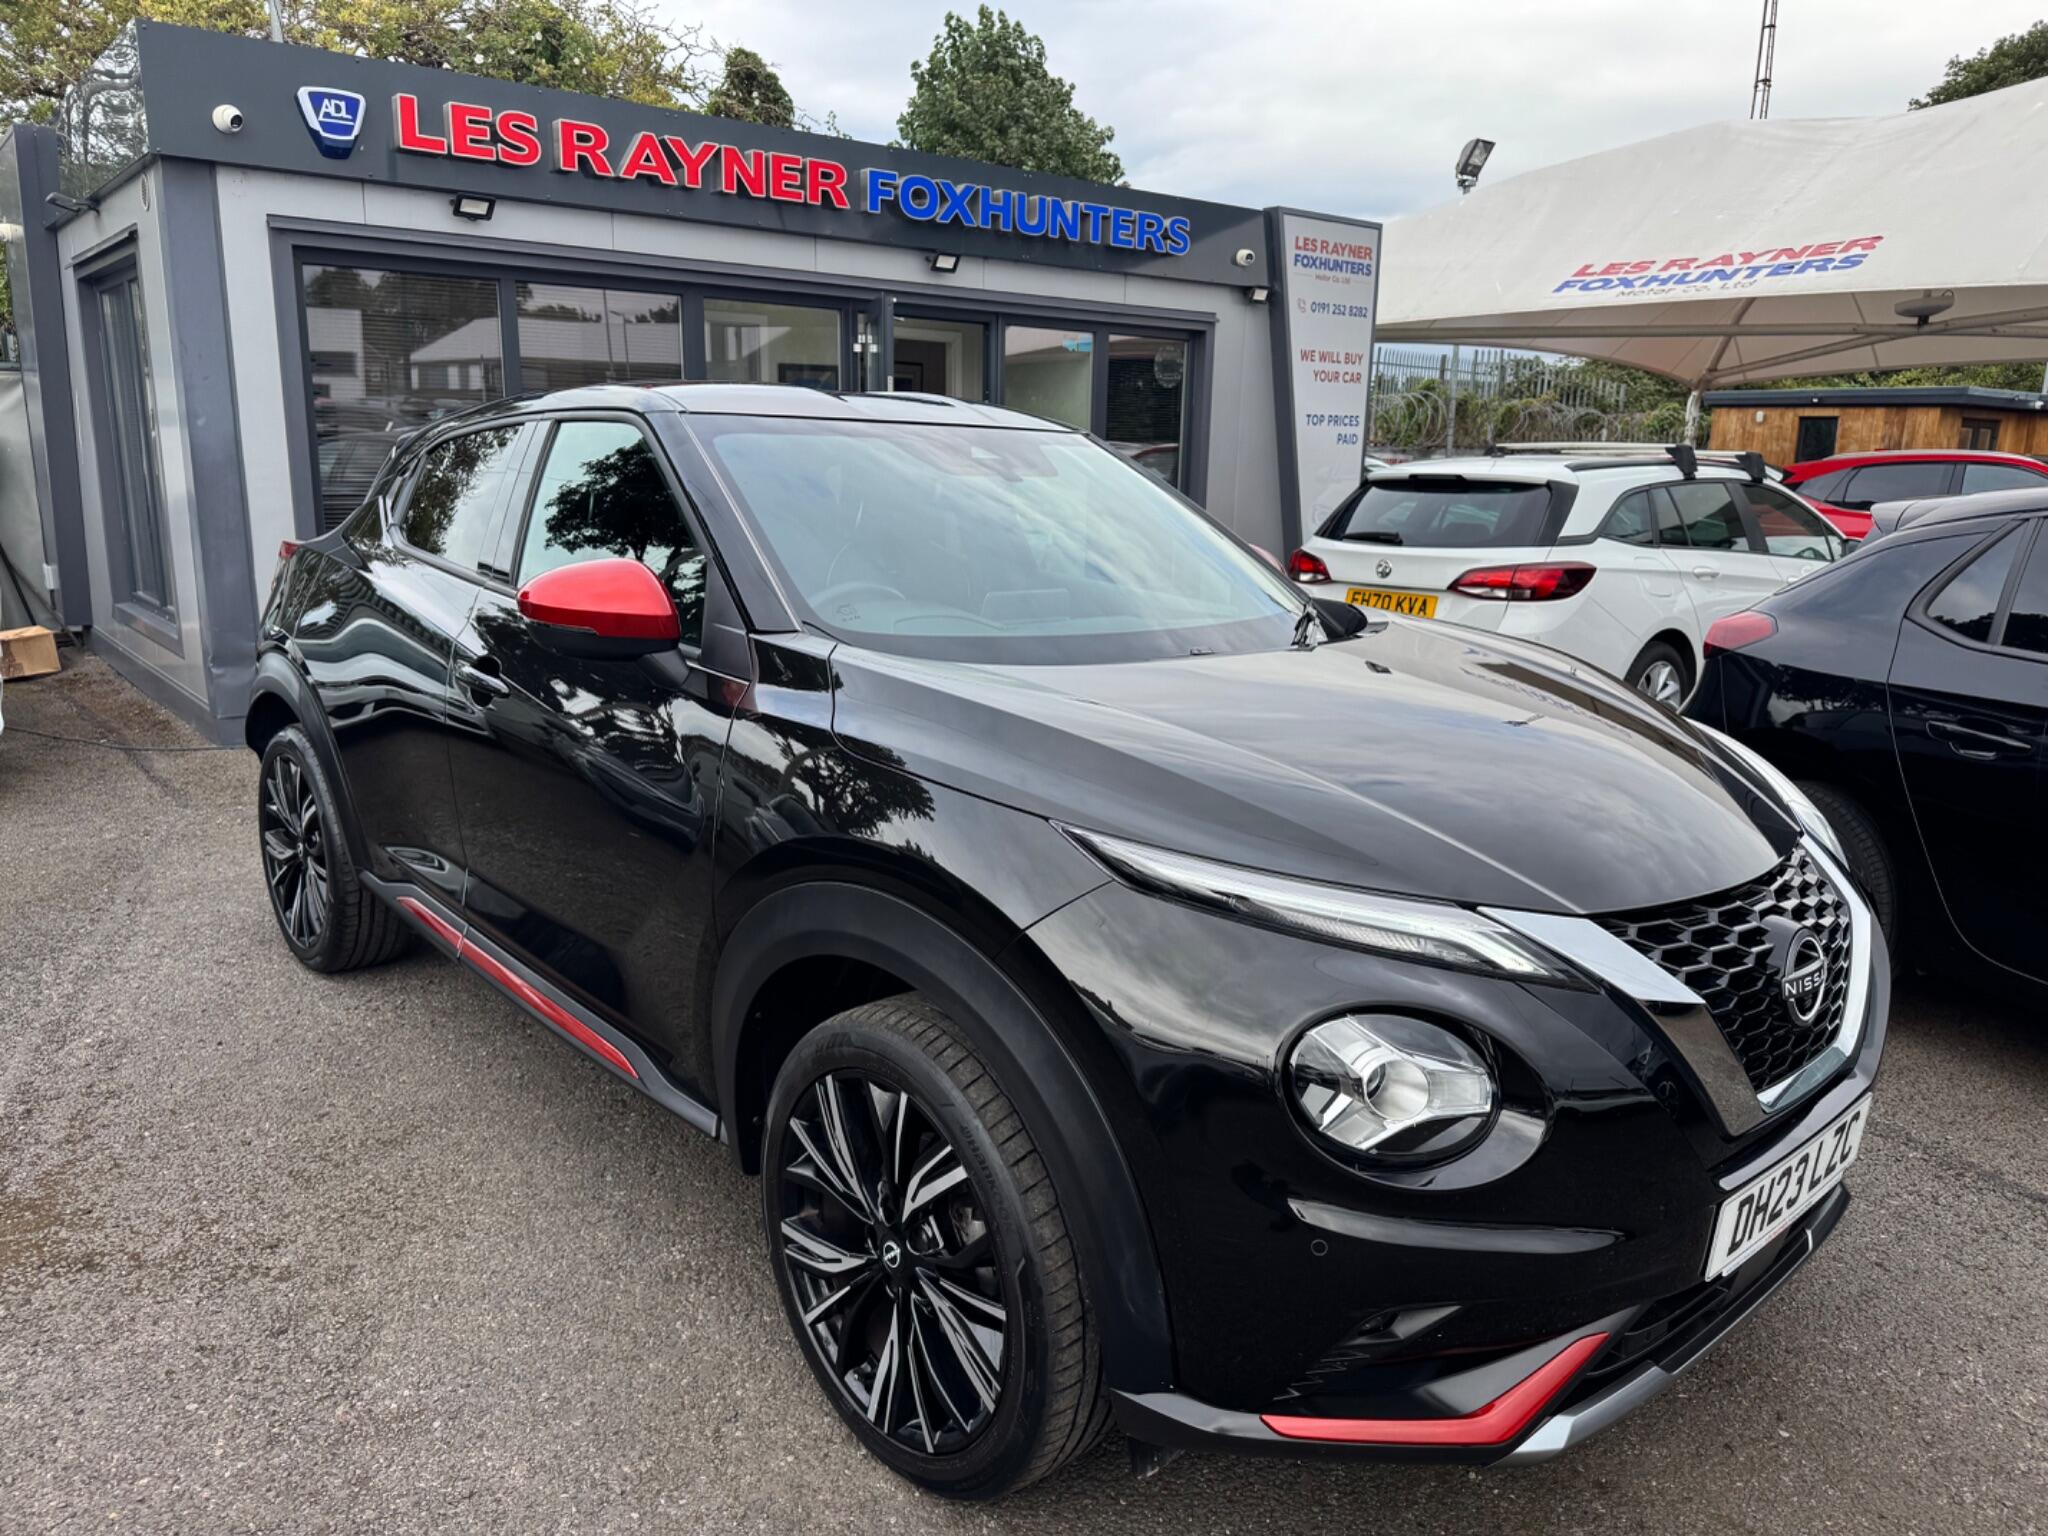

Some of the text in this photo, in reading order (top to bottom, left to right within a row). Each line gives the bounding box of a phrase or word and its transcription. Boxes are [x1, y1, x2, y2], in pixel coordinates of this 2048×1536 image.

[393, 92, 1191, 257] LES RAYNER FOXHUNTERS
[1295, 236, 1373, 261] LES RAYNER
[1571, 235, 1885, 279] LES RAYNER
[1293, 253, 1372, 277] FOXHUNTERS
[1552, 253, 1870, 293] FOXHUNTERS
[1311, 301, 1368, 319] 0191 252 8282
[1300, 349, 1363, 366] WE WILL BUY
[1313, 370, 1361, 384] YOUR CAR
[1306, 414, 1360, 427] TOP PRICES
[1337, 432, 1358, 445] PAID
[1395, 595, 1427, 615] KVA
[1727, 1110, 1861, 1256] DH23 LZC
